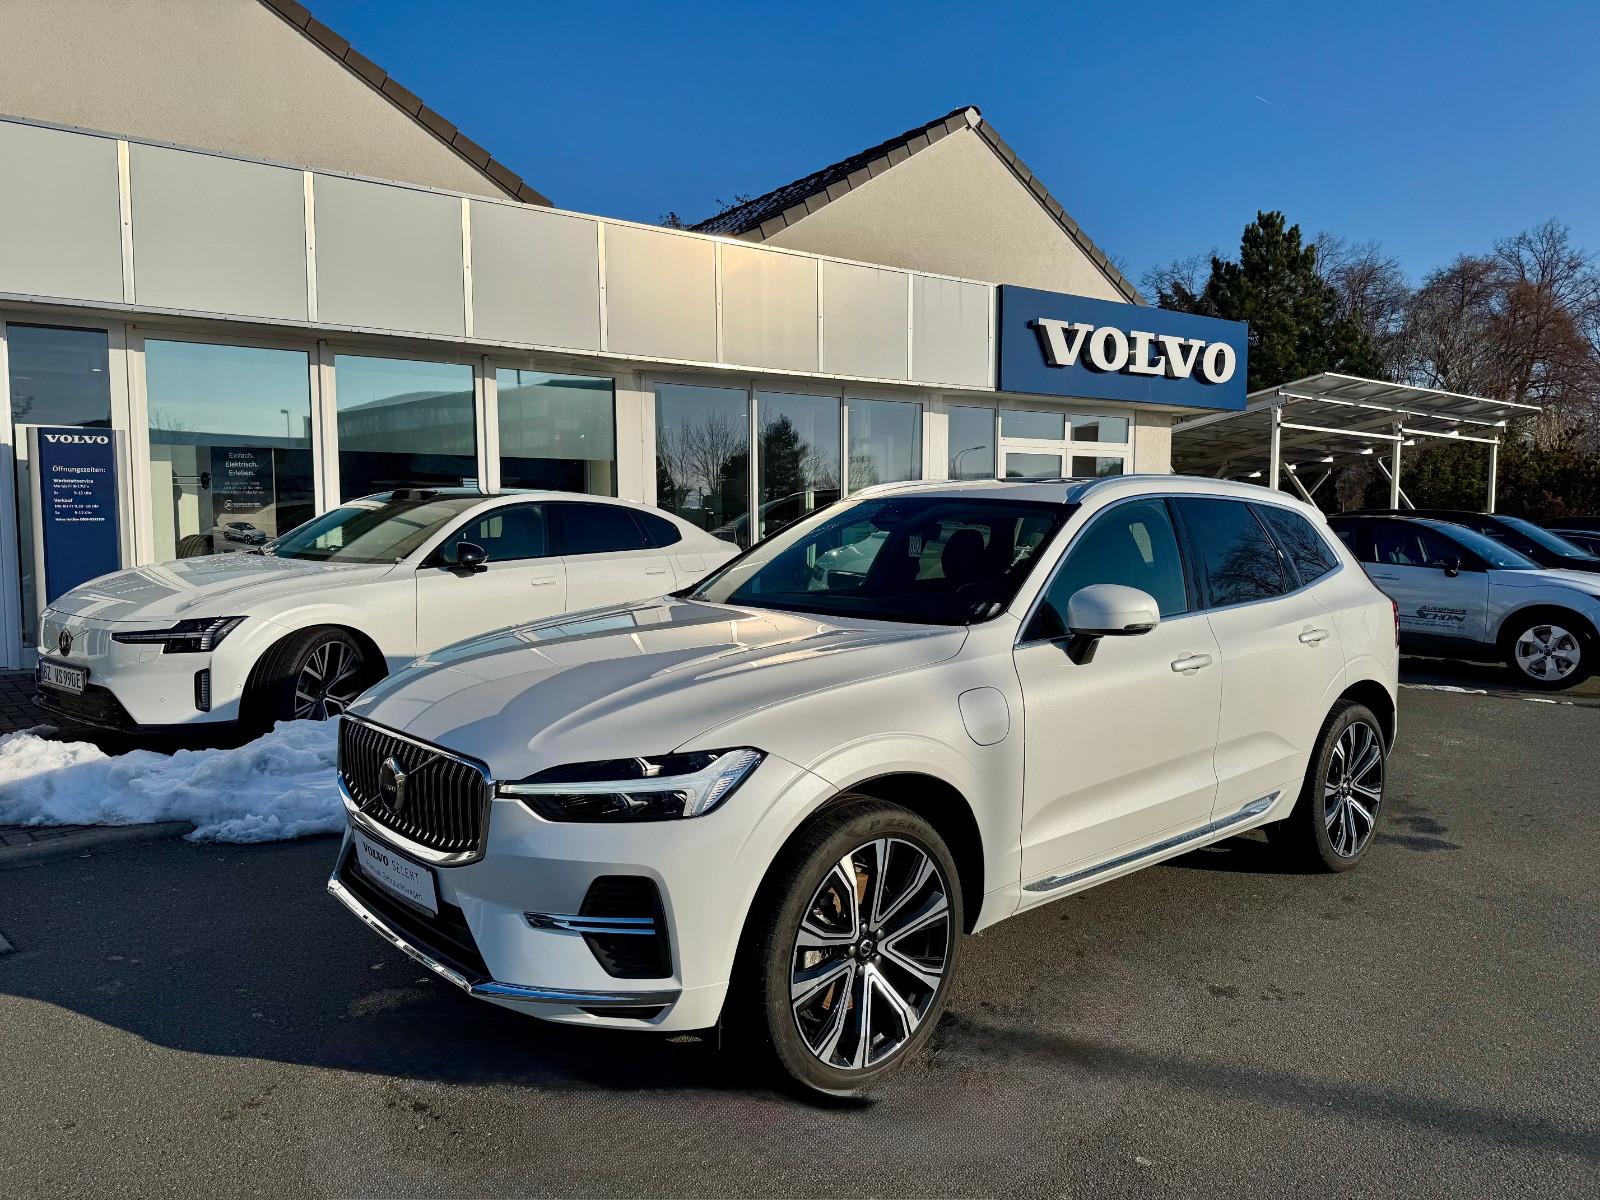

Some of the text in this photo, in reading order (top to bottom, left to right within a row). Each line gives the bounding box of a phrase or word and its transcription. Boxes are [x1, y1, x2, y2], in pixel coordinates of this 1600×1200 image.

[1037, 317, 1236, 384] VOLVO
[44, 434, 109, 444] VOLVO
[52, 465, 106, 474] Öffnungszeiten:
[1419, 604, 1467, 613] Autohaus
[363, 842, 389, 866] VOLVO
